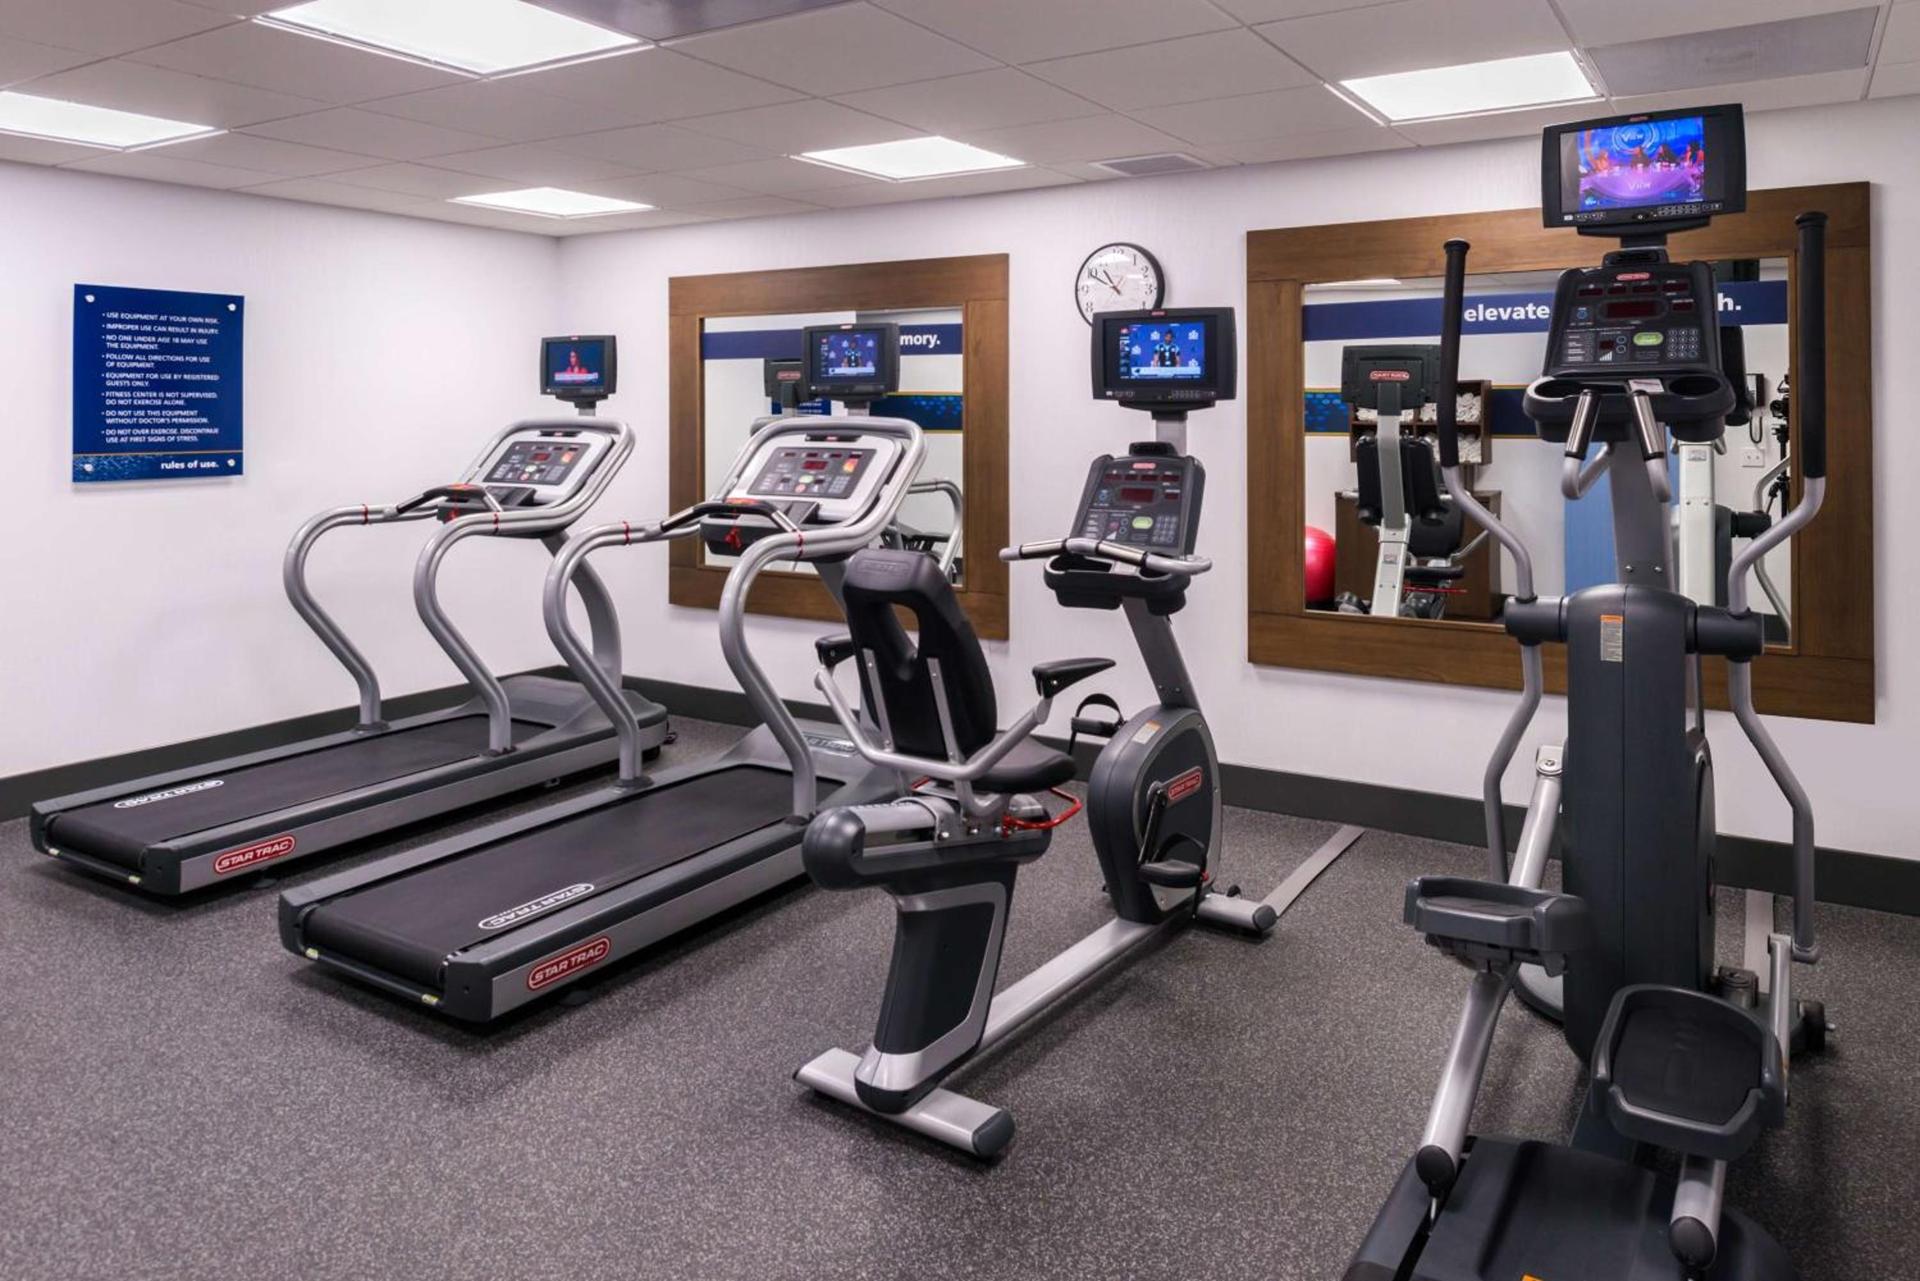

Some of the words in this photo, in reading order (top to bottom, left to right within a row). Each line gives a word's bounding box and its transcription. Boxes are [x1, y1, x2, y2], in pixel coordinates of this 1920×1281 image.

[1132, 254, 1137, 265] 1
[1141, 265, 1148, 278] 2
[1145, 283, 1153, 295] 3
[1086, 301, 1093, 312] 8
[1463, 303, 1550, 321] elevate
[900, 334, 940, 348] mory.
[161, 461, 185, 469] rules
[187, 460, 198, 469] of
[218, 853, 254, 868] STAR
[255, 841, 289, 856] TRAC
[542, 886, 586, 904] STAR
[491, 904, 541, 926] TRAC
[534, 962, 569, 980] STAR
[570, 944, 604, 966] TRAC
